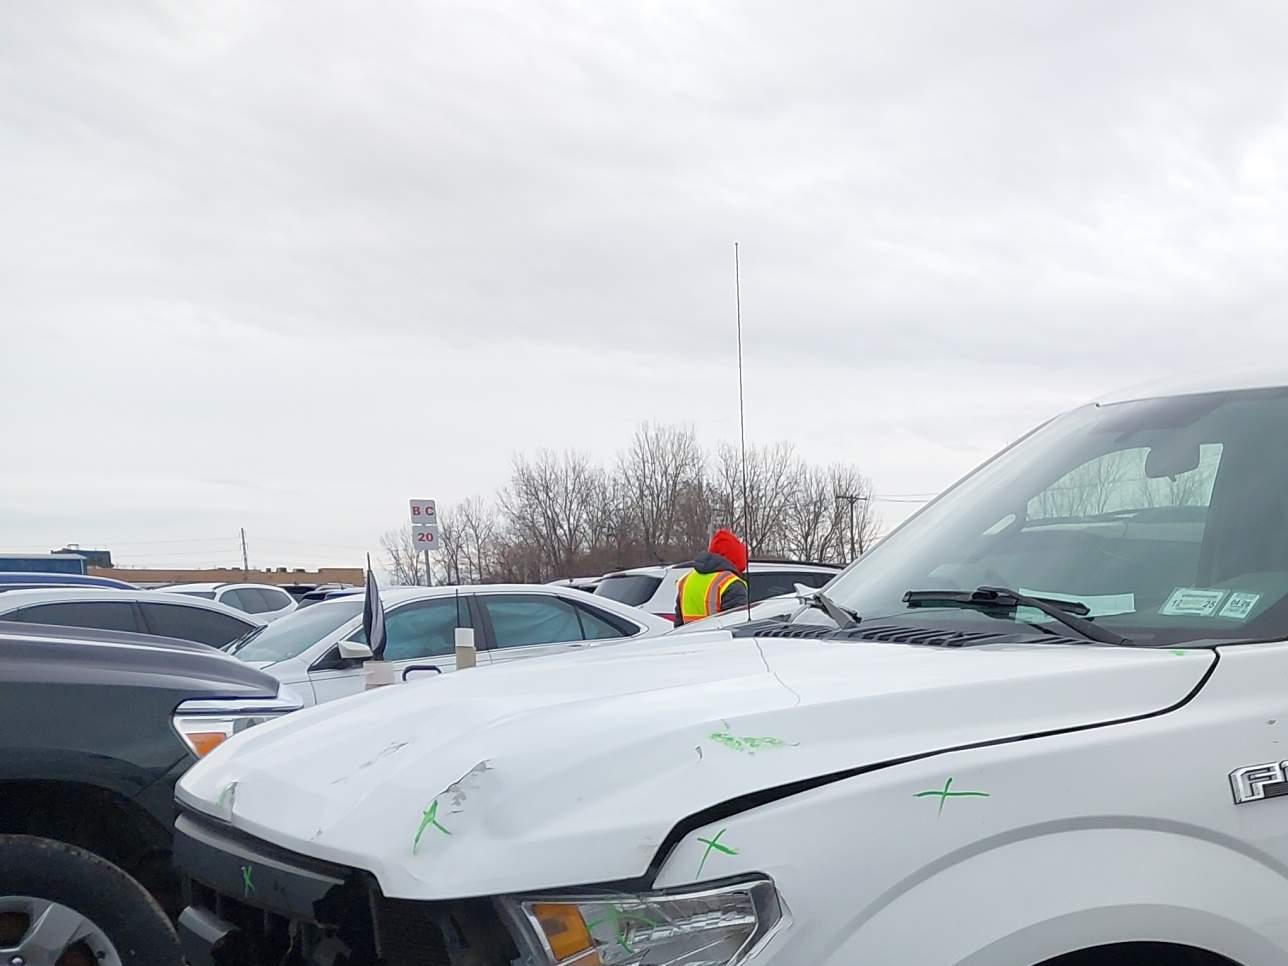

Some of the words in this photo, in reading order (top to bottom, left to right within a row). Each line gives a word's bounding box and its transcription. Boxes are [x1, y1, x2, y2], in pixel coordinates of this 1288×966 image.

[412, 506, 421, 516] B
[425, 506, 434, 516] C
[417, 532, 434, 542] 20
